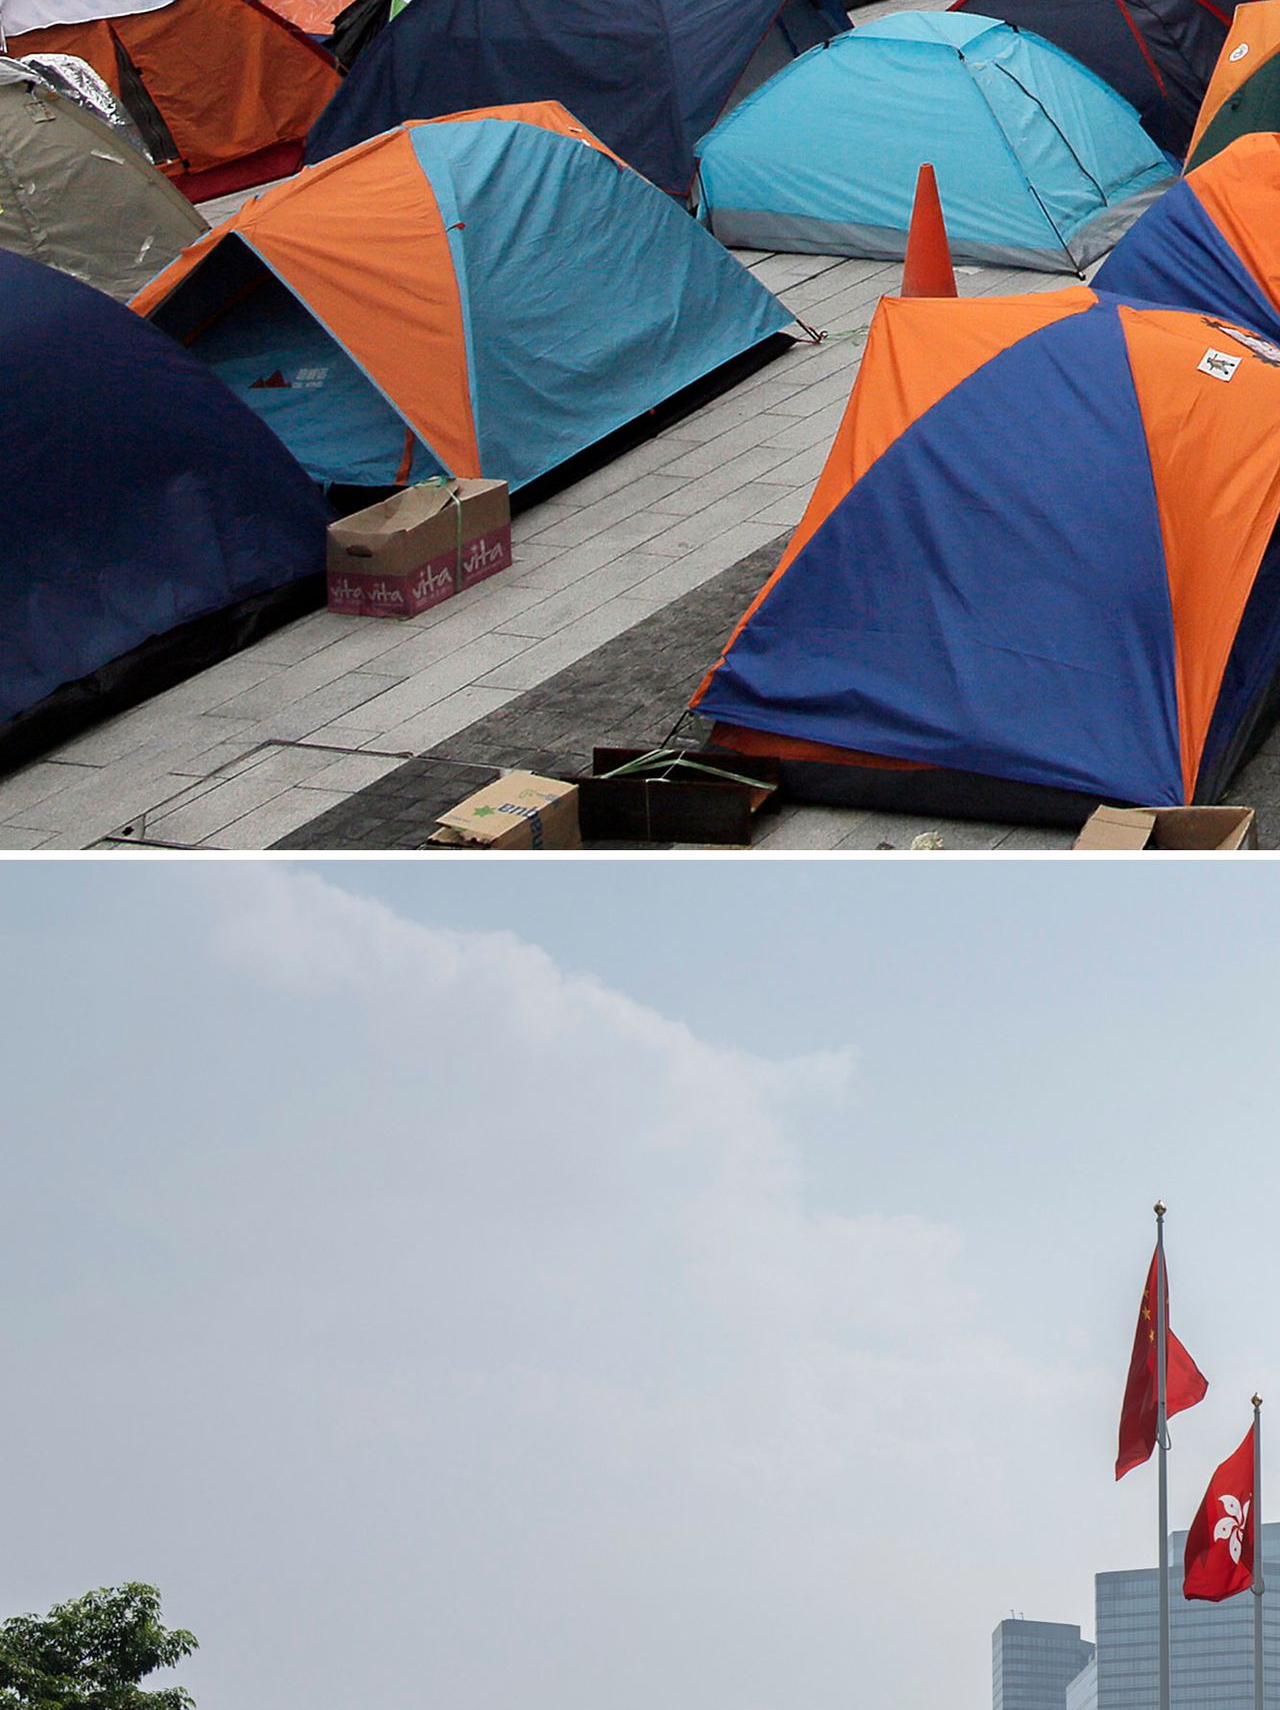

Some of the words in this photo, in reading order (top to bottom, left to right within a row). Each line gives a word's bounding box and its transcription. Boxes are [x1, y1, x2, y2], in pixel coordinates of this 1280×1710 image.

[463, 539, 503, 573] vita
[331, 579, 363, 600] vita
[367, 582, 404, 603] vita
[412, 565, 453, 599] vita
